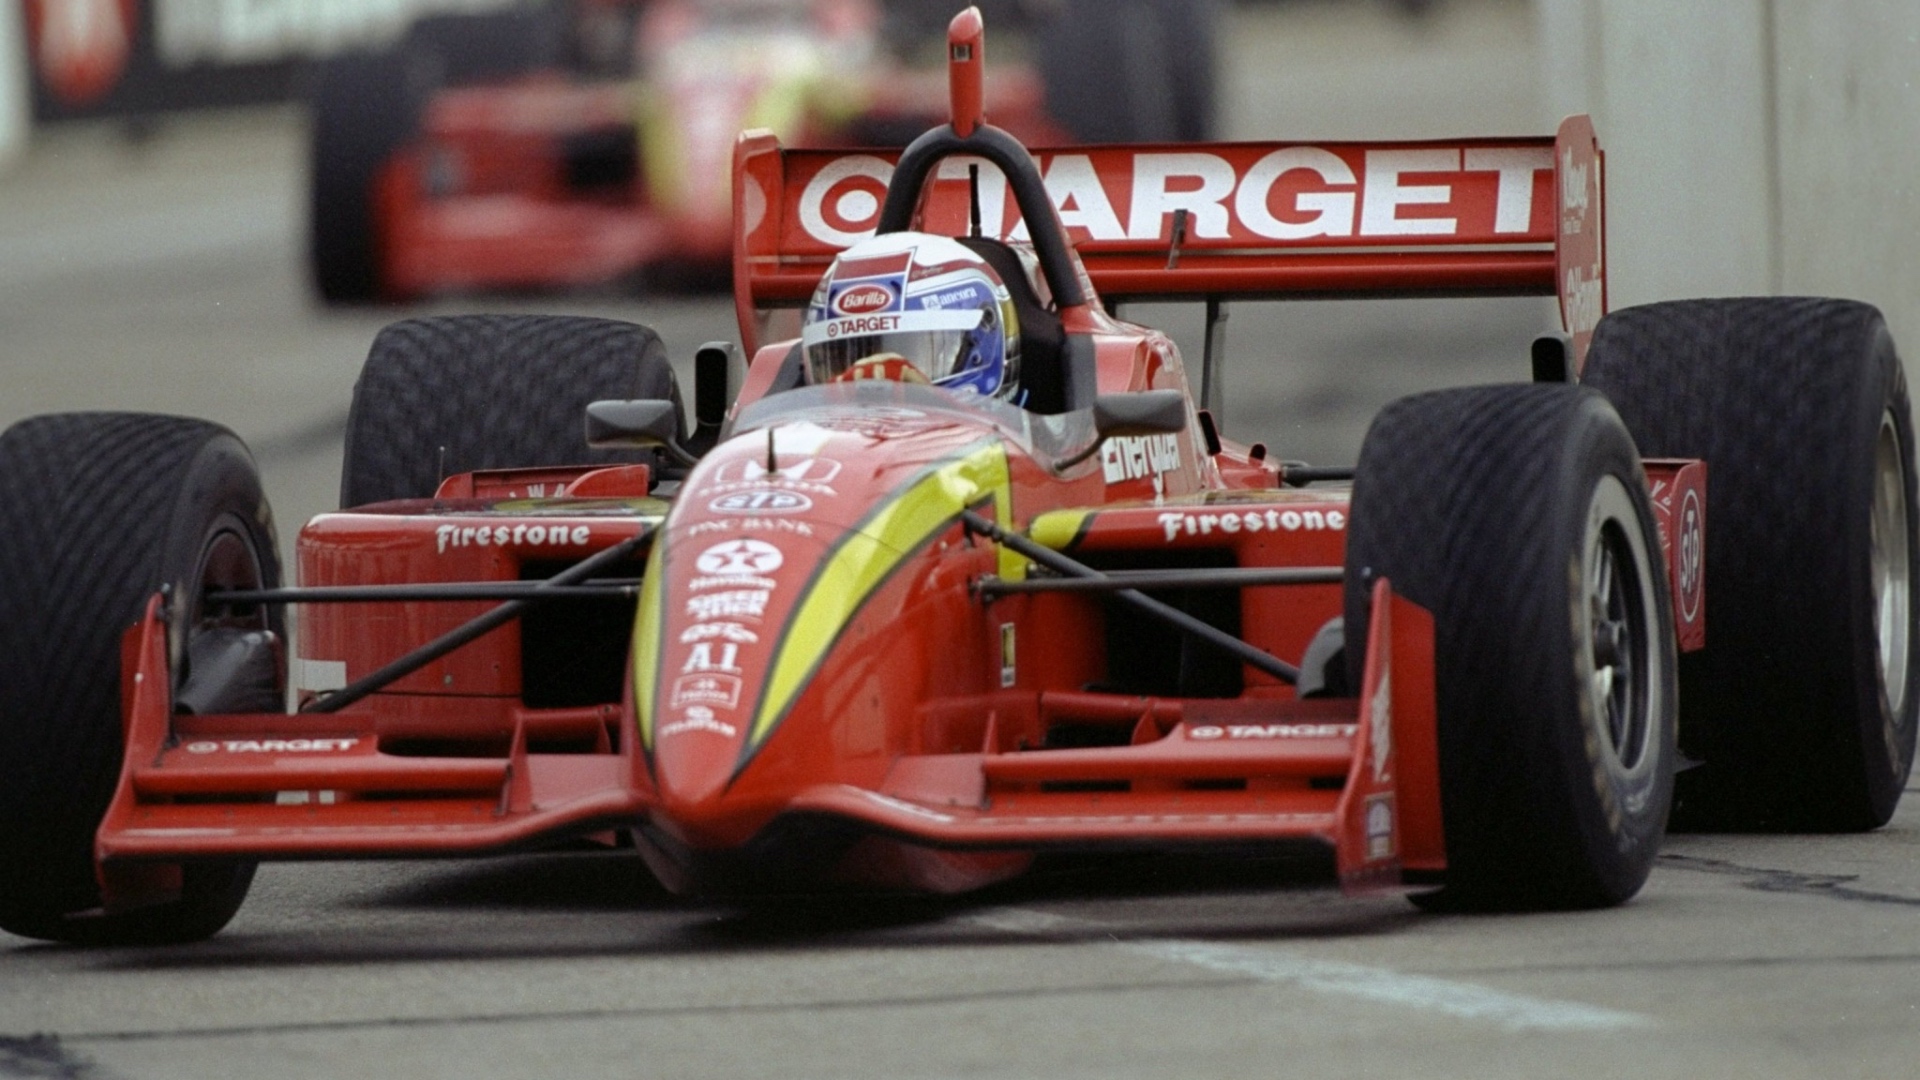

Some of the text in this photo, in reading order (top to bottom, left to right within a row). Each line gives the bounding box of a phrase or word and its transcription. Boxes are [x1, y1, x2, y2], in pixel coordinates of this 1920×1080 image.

[937, 147, 1554, 240] TARGET
[843, 291, 886, 309] Barilla
[840, 316, 900, 334] TARGET
[722, 492, 798, 509] STP
[1157, 509, 1345, 542] Firestone
[435, 524, 590, 554] Firestone
[1681, 509, 1699, 594] STP
[1226, 724, 1359, 738] TARGET
[223, 739, 358, 753] TARGET
